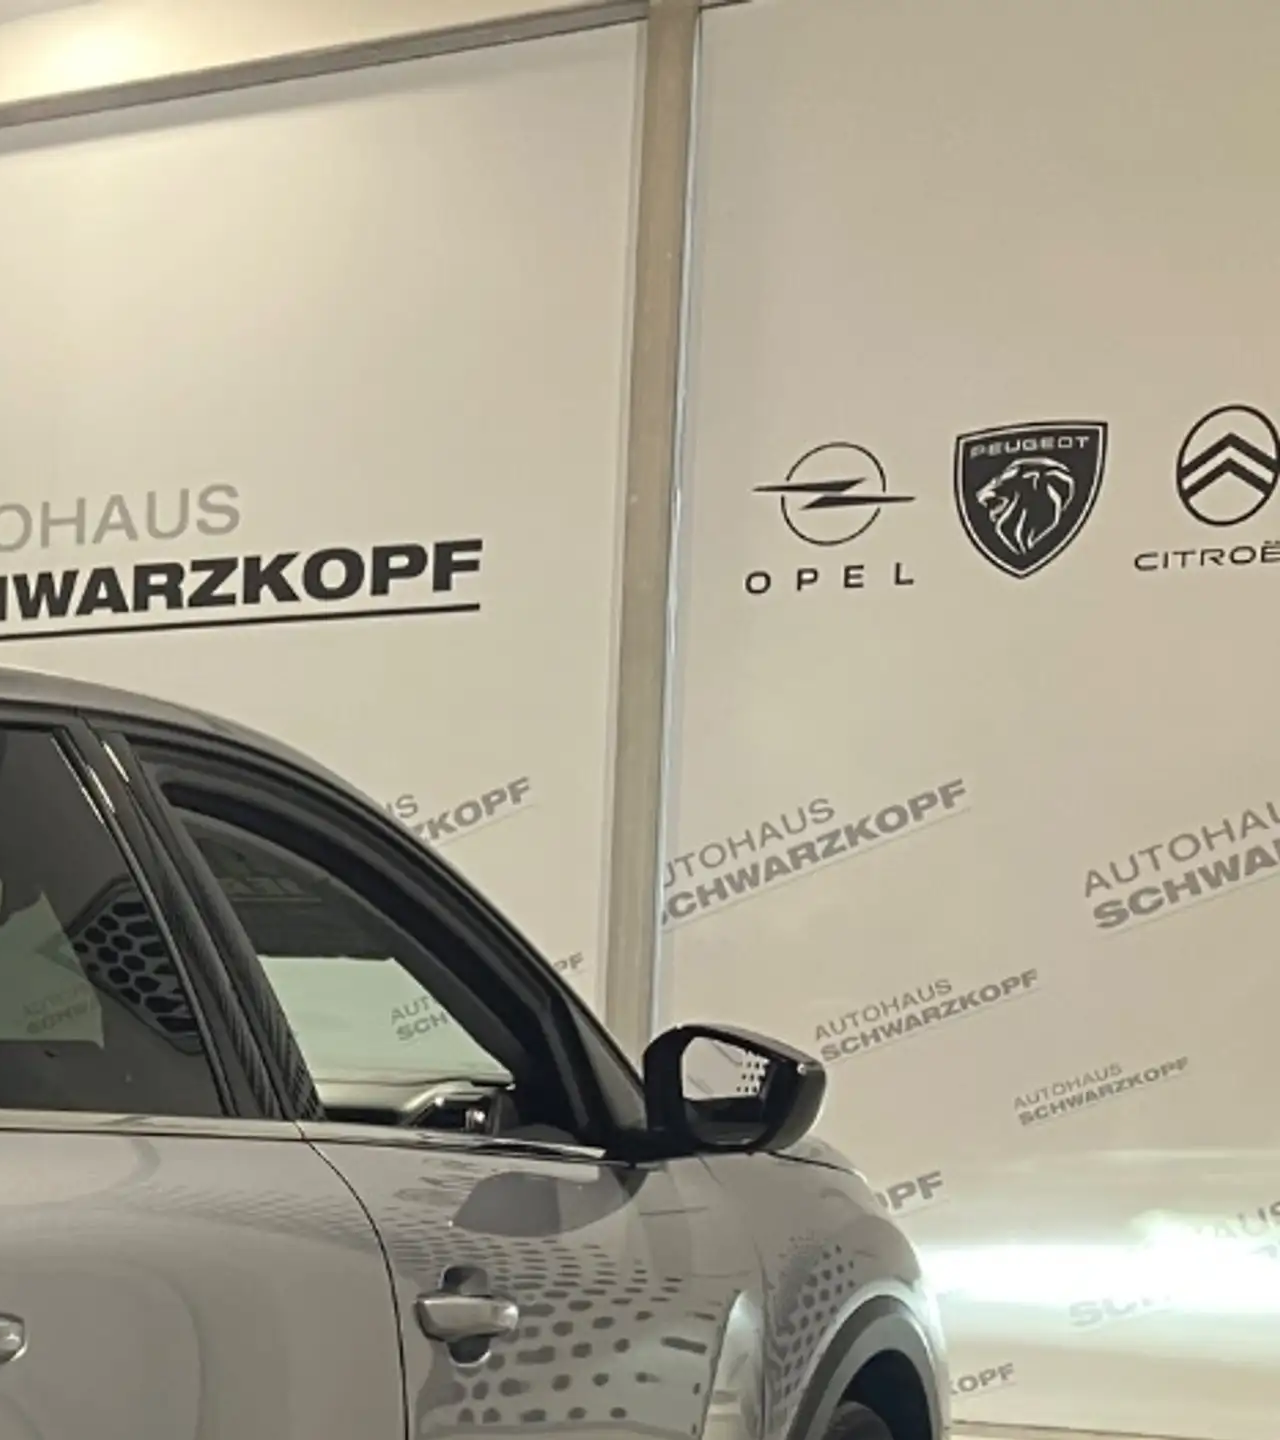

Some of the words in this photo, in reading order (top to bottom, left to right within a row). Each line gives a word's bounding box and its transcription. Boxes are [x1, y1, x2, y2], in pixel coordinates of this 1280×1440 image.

[970, 435, 1090, 460] PEUGEOT
[744, 562, 914, 594] OPEL
[662, 778, 967, 926] CHWARZKOPF
[814, 978, 953, 1042] AUTOHAUS
[820, 968, 1039, 1063] SCHWARZKOPF
[1013, 1062, 1123, 1111] AUTOHAUS
[1018, 1056, 1189, 1126] SCHWARZKOPF
